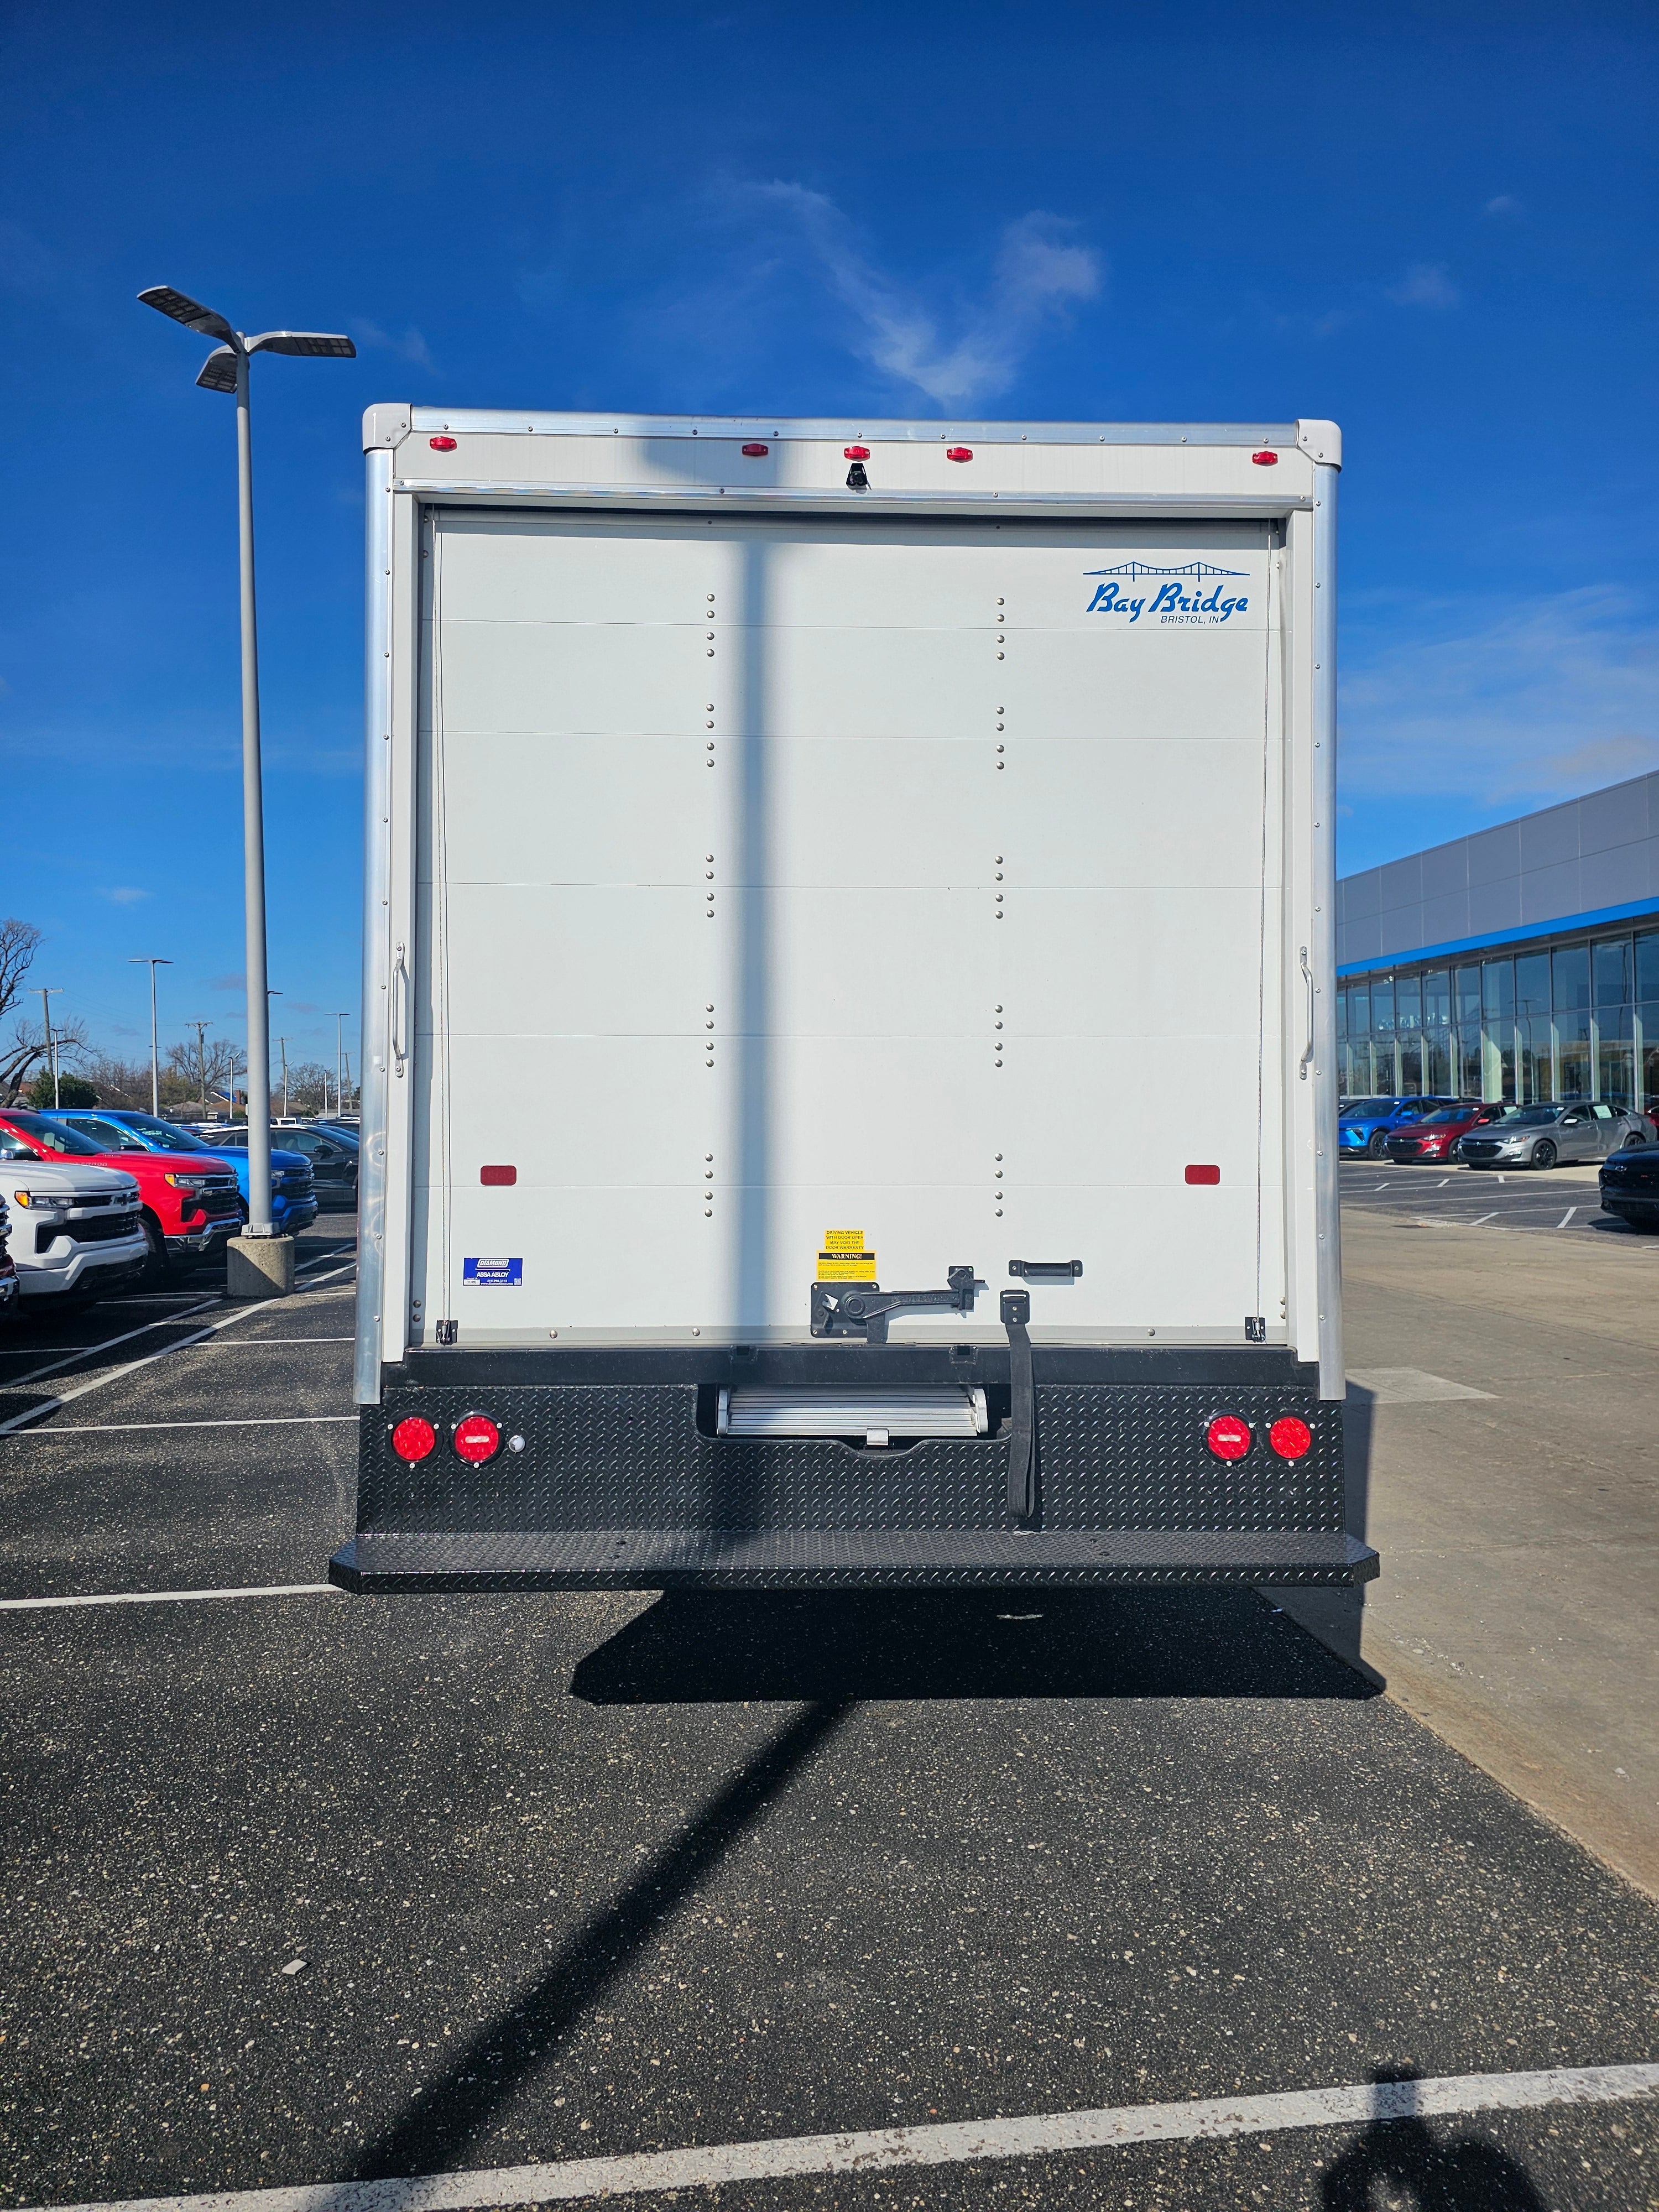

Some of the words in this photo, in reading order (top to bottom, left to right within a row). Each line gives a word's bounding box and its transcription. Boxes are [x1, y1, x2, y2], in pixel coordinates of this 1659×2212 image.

[1086, 582, 1146, 623] Bay
[1148, 582, 1249, 622] Bridge
[1161, 615, 1206, 624] BRISTOL,
